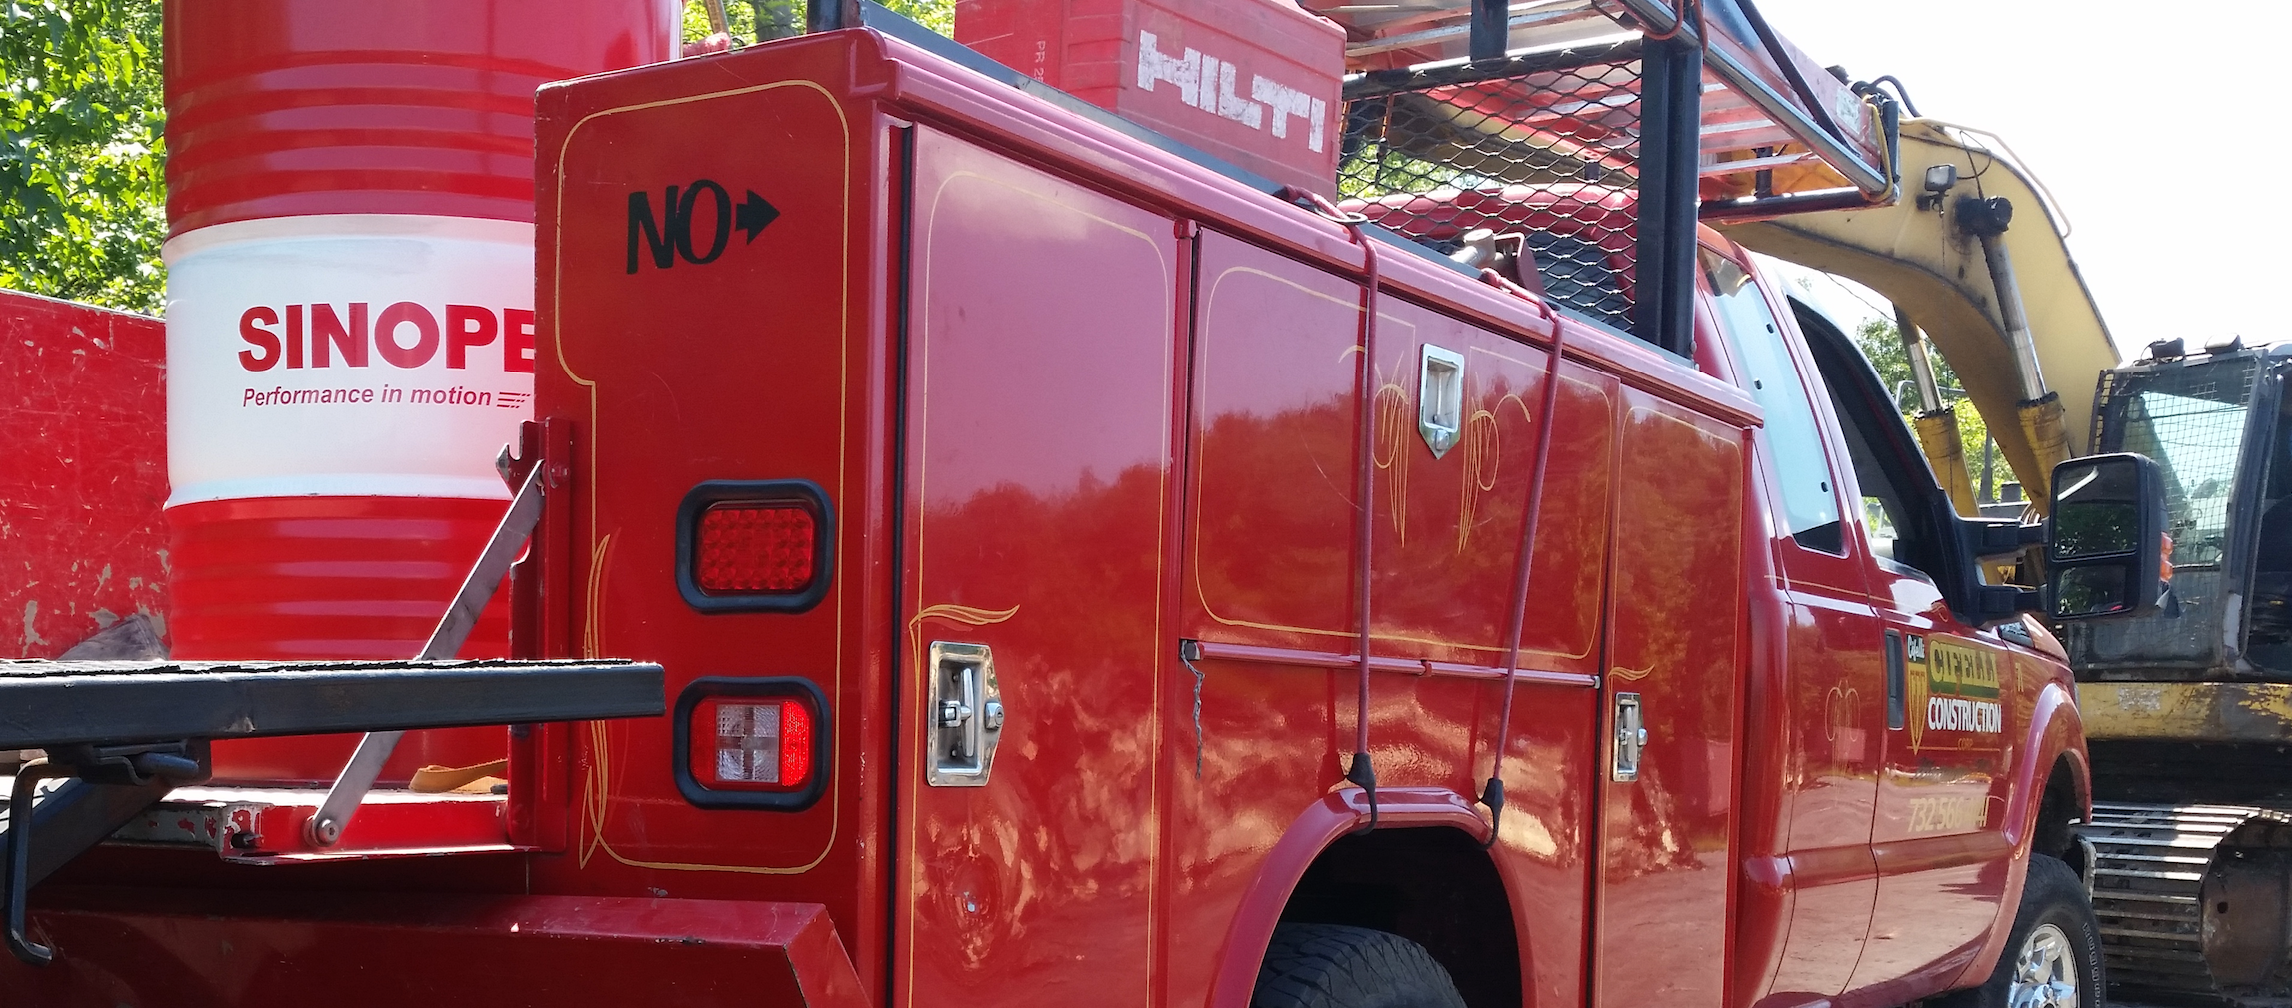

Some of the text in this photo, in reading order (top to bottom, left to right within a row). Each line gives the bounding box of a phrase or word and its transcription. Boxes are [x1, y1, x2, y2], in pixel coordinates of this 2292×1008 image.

[1034, 40, 1046, 63] PR
[1137, 29, 1326, 154] HILTI
[626, 179, 731, 275] NO
[243, 384, 492, 407] Performance in motion
[1929, 640, 1999, 694] CIFELLI
[1928, 696, 2002, 733] CONSTRUCTION
